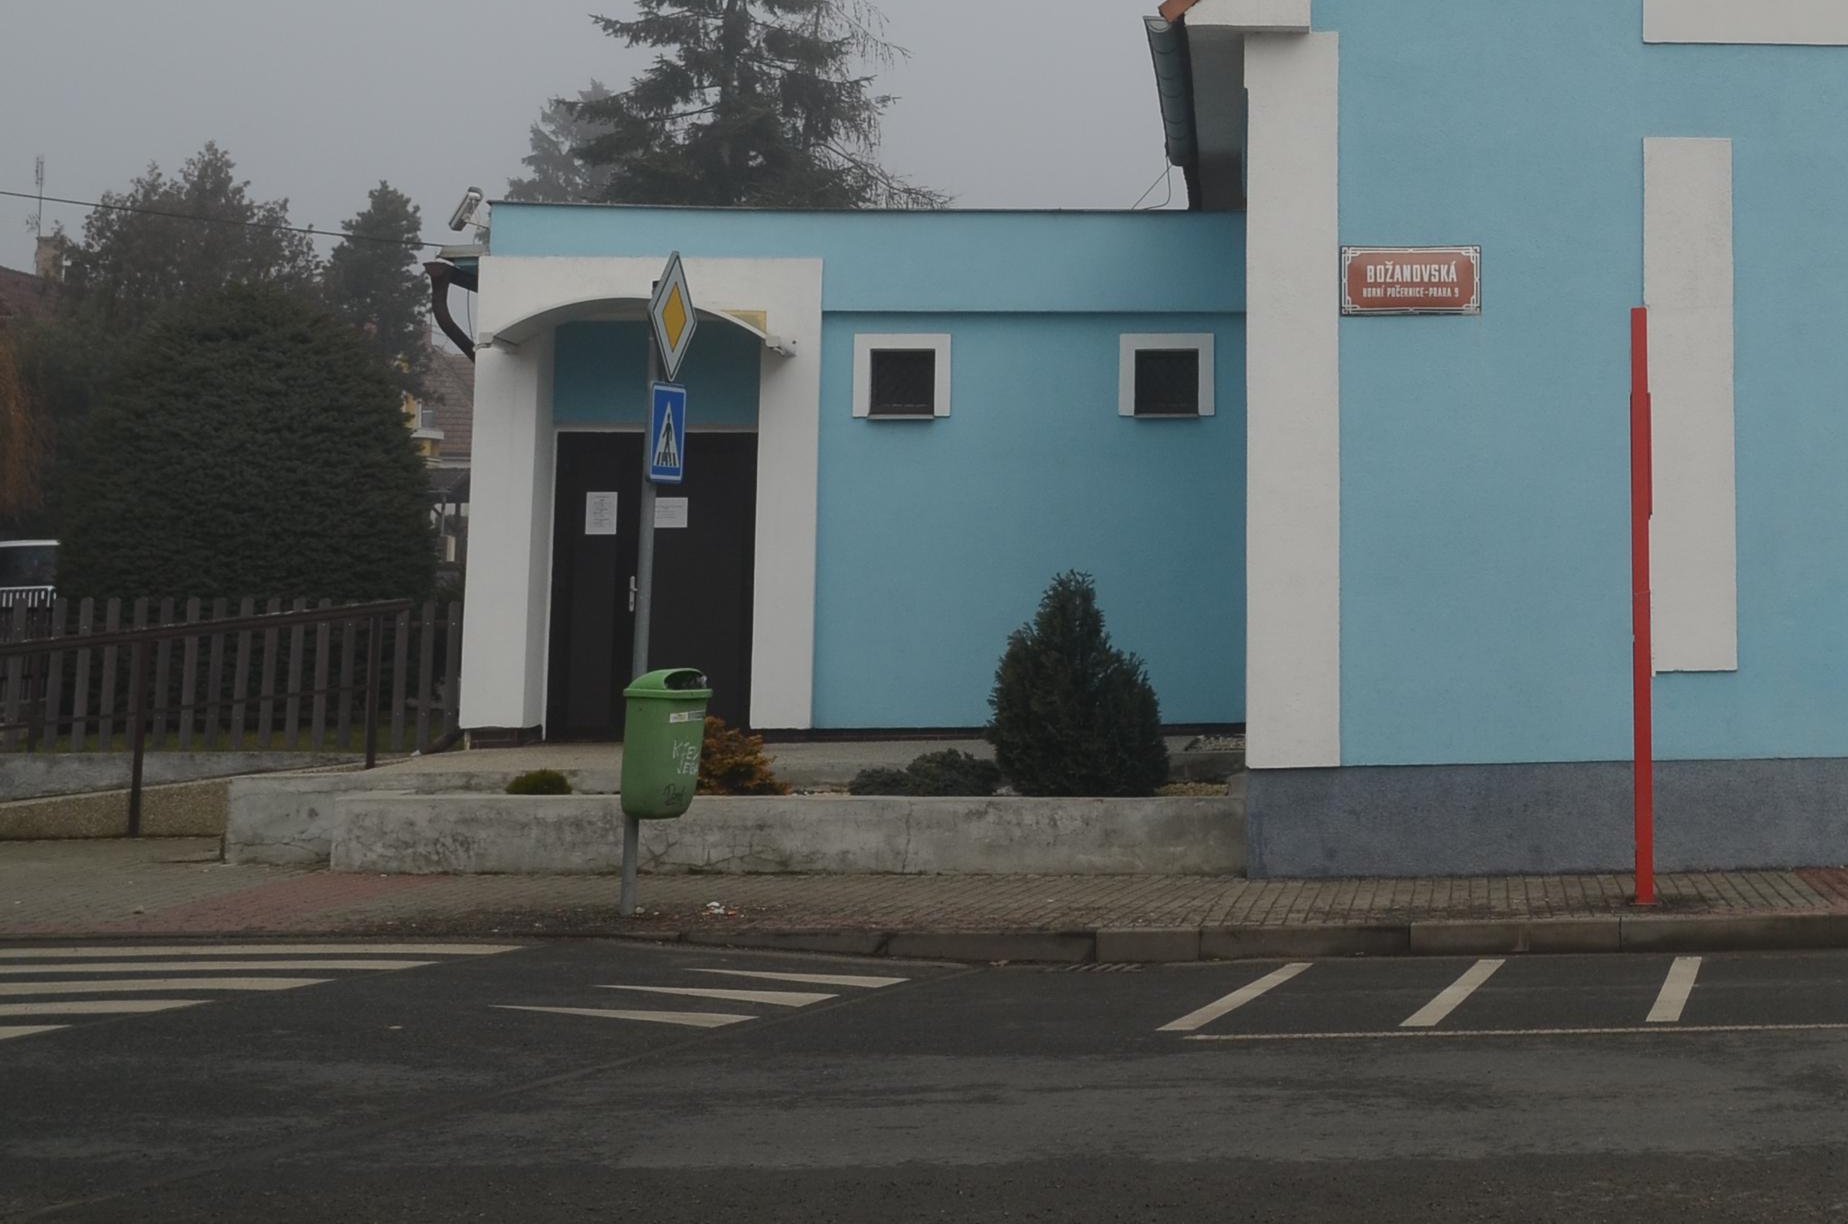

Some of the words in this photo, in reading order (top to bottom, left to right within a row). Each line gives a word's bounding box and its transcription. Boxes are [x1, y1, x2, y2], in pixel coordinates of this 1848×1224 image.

[1366, 261, 1457, 283] BOŽANOVSKÁ
[1362, 285, 1385, 297] HORNÍ
[1454, 287, 1460, 298] 9
